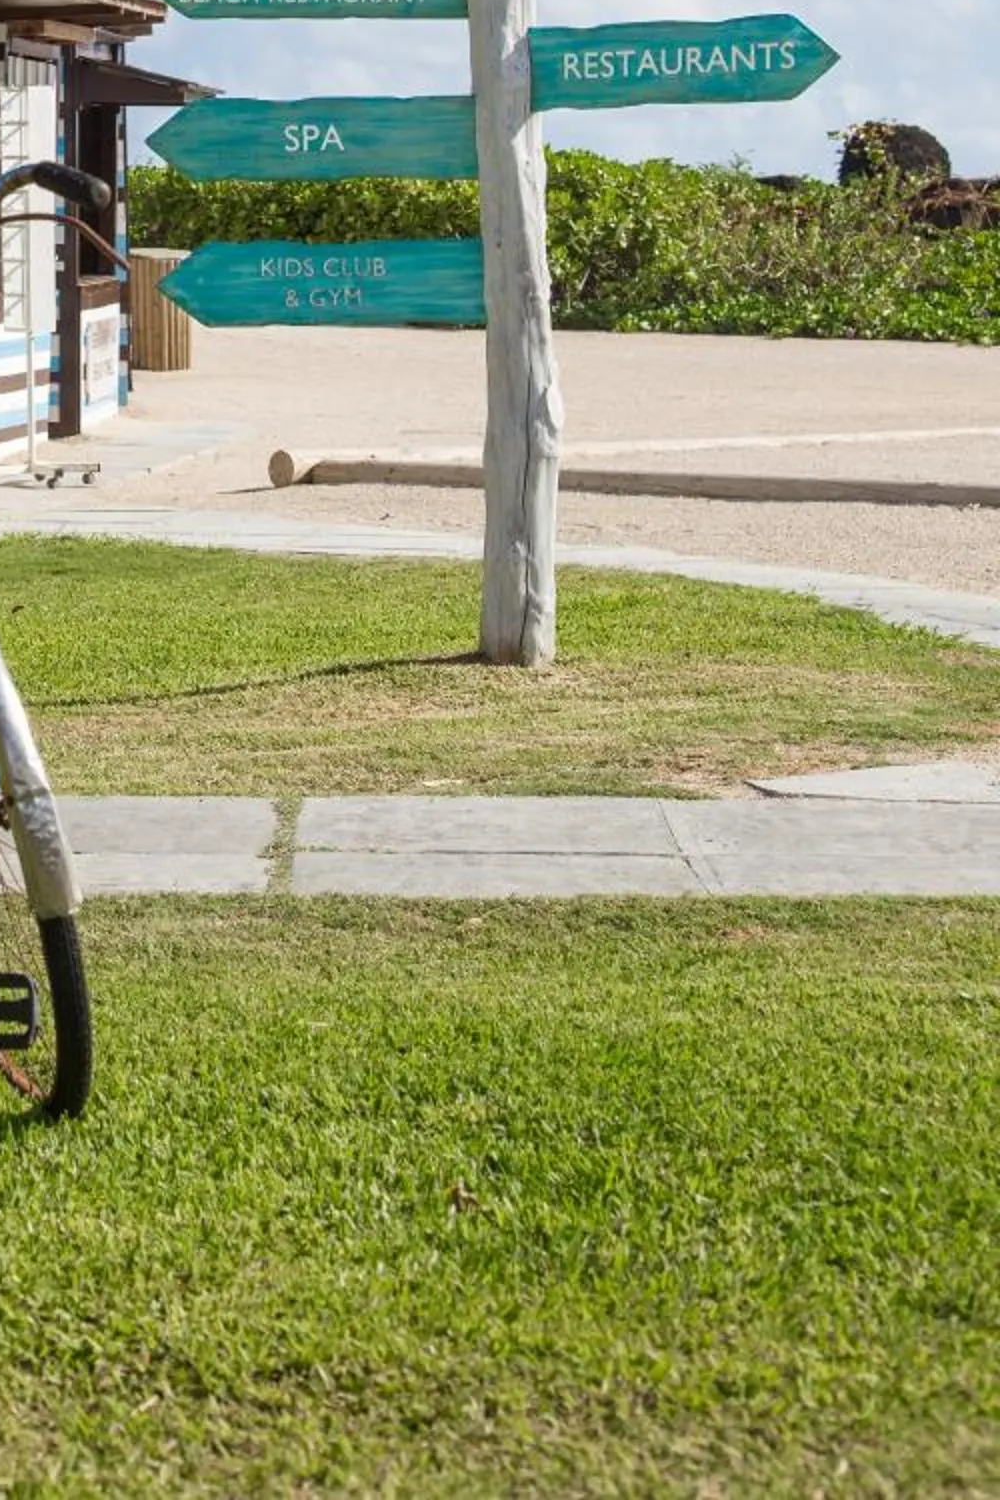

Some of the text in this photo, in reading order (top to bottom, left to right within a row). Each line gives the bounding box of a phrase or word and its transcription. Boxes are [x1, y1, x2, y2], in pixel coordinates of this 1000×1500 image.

[563, 41, 796, 80] RESTAURANTS
[284, 124, 345, 152] SPA
[260, 257, 387, 277] KIDS CLUB
[284, 287, 362, 308] & GYM
